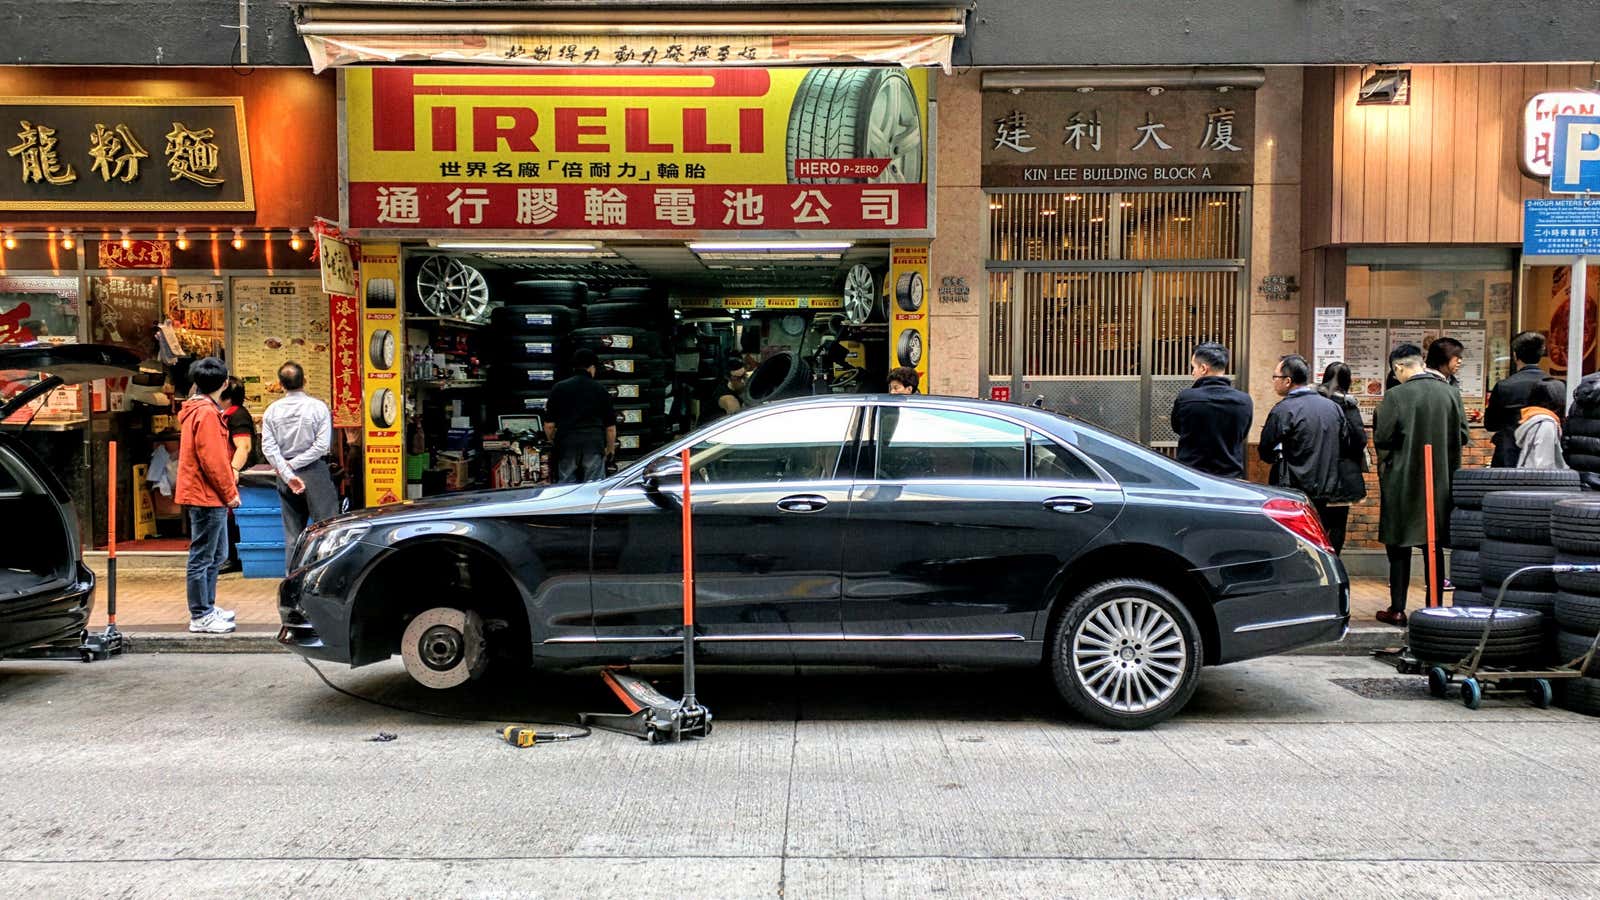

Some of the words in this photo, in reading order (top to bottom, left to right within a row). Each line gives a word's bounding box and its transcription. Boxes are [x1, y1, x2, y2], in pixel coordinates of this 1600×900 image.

[372, 67, 771, 153] PIRELLI
[993, 106, 1243, 152] 建利大廈
[8, 120, 225, 187] 龍粉麵
[440, 160, 706, 181] 世界名廠「倍耐力」輪胎
[800, 162, 840, 175] HERO
[843, 165, 879, 174] P-ZERO
[1024, 168, 1047, 180] KIN
[1054, 168, 1077, 180] LEE
[1083, 168, 1147, 180] BUILDING
[1154, 167, 1197, 180] BLOCK
[1202, 167, 1211, 180] A
[1564, 123, 1600, 184] P
[376, 186, 900, 227] 通行膠輪電池公司
[811, 299, 840, 307] PIRELLI
